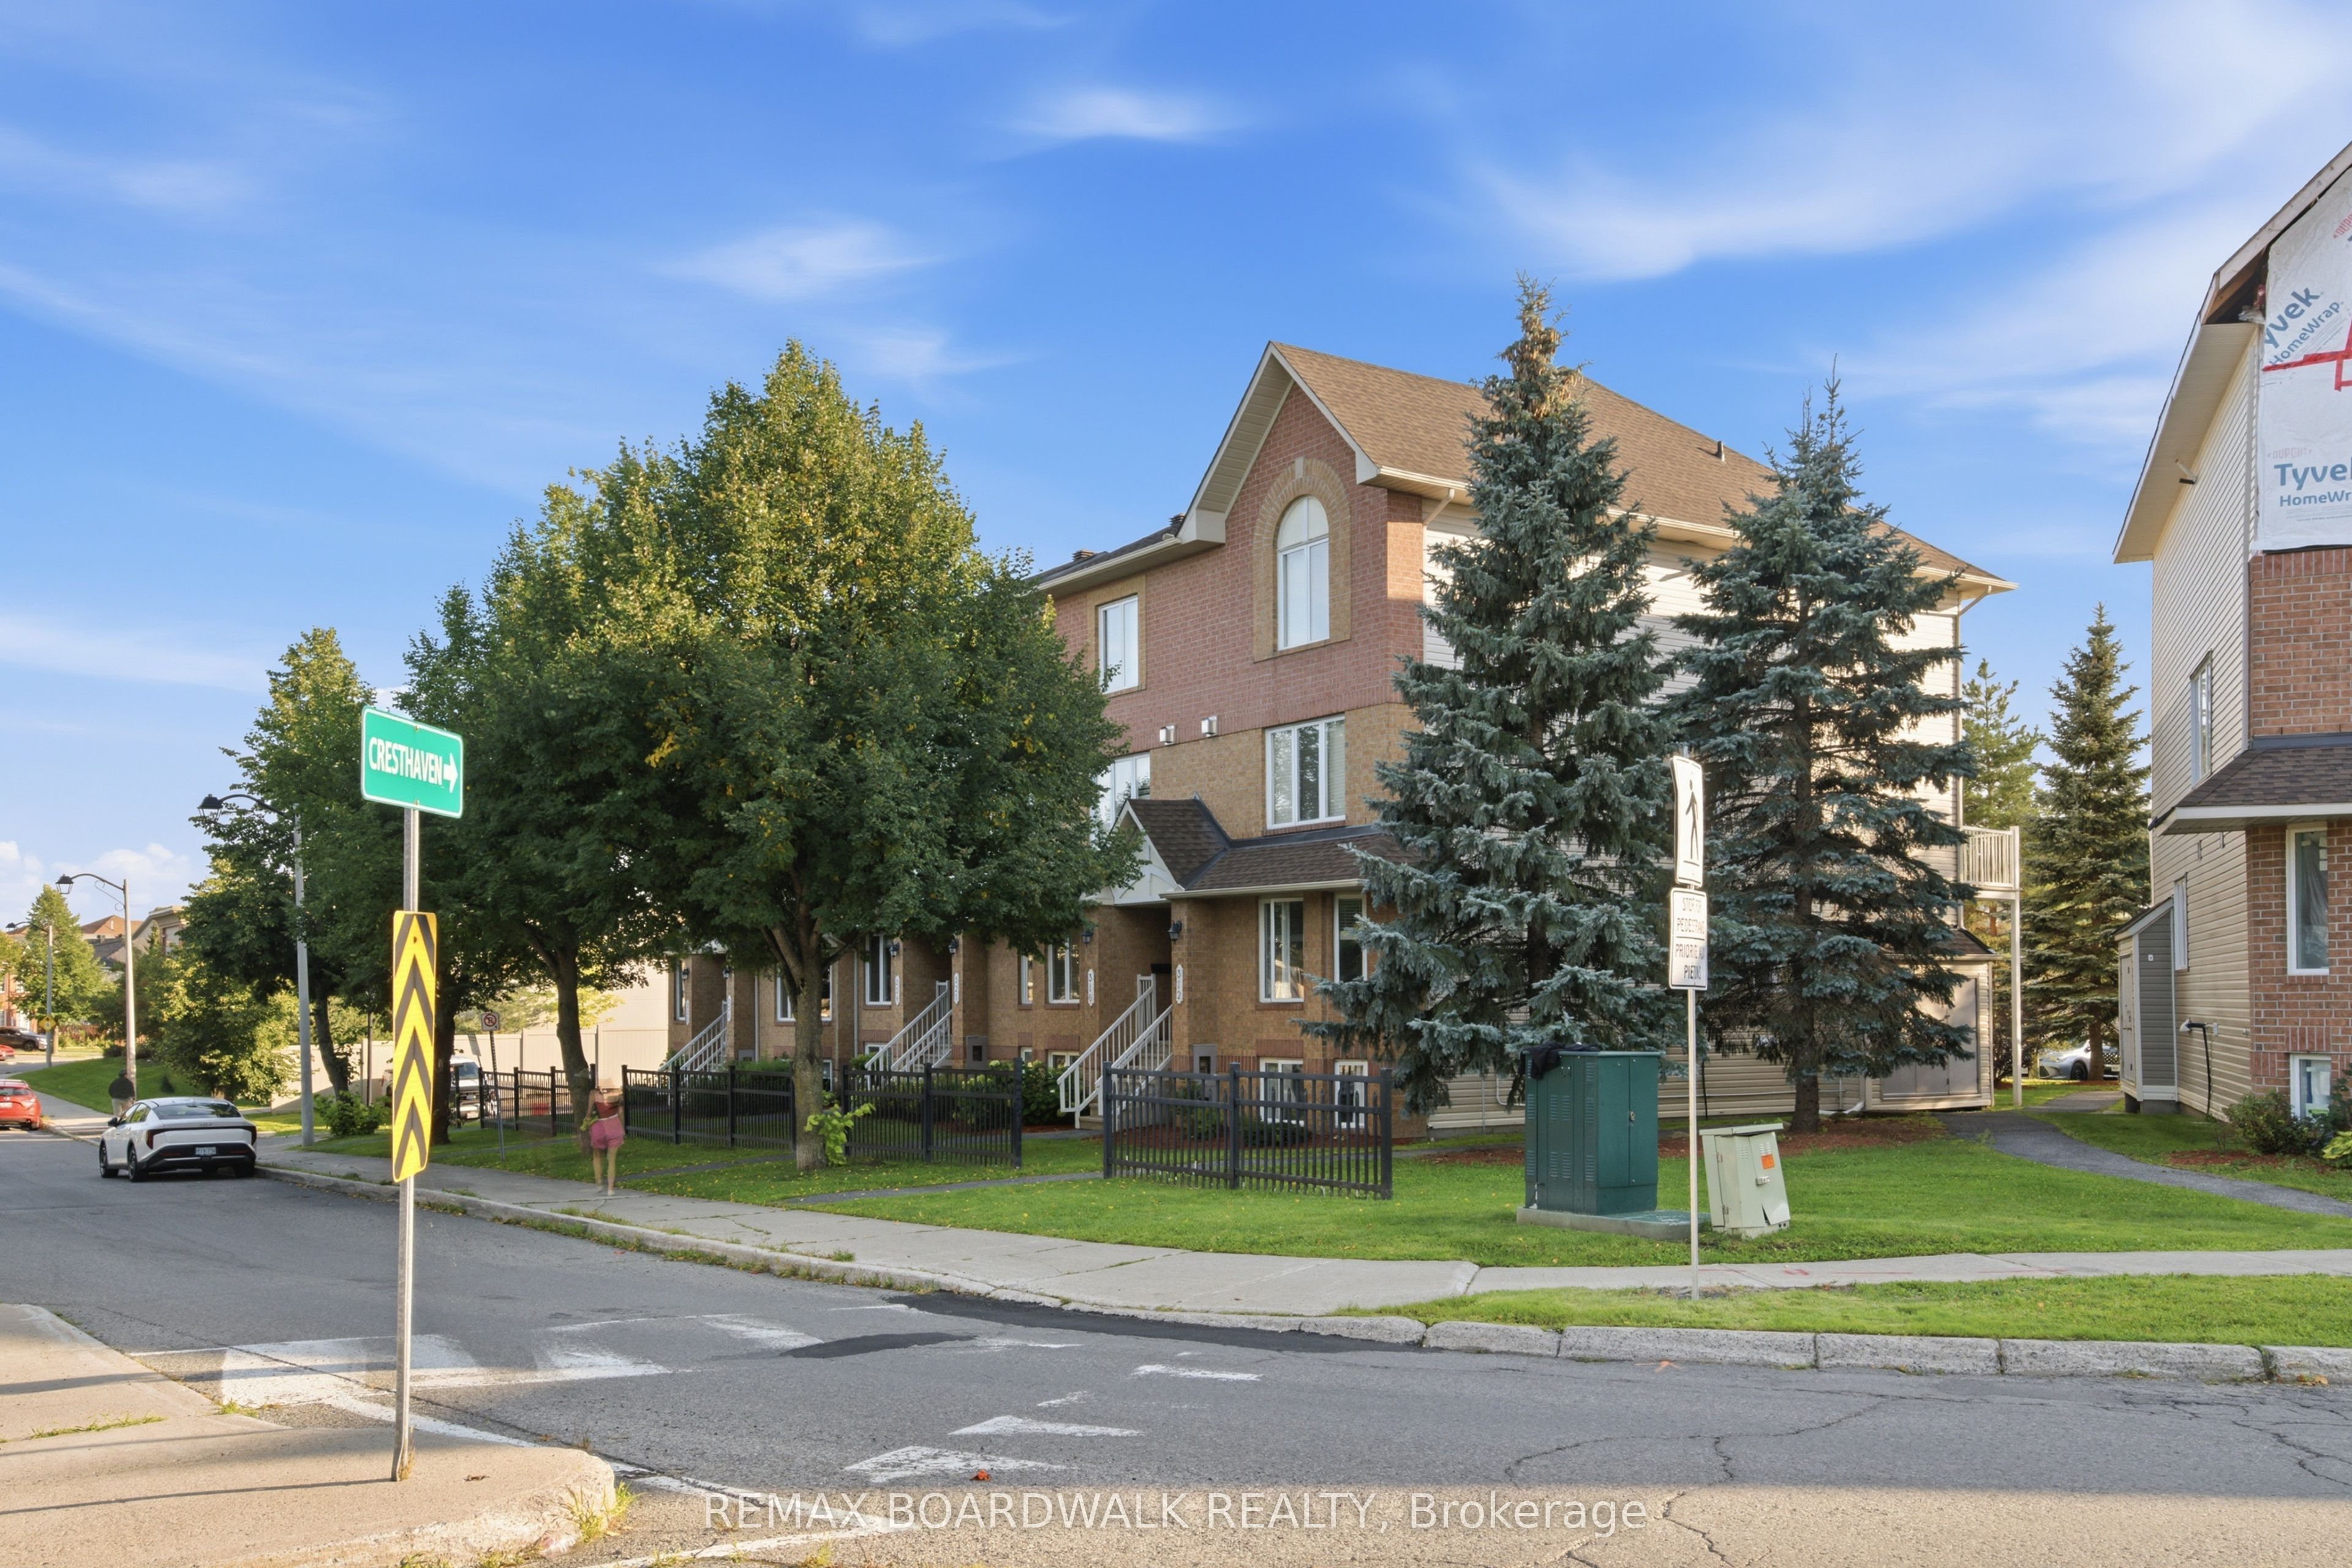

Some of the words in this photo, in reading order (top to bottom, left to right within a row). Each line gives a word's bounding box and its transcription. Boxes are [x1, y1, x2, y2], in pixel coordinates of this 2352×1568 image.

[2269, 302, 2340, 366] HomeWrap
[2274, 456, 2352, 491] Tyve
[369, 737, 442, 785] CRESTHAVEN
